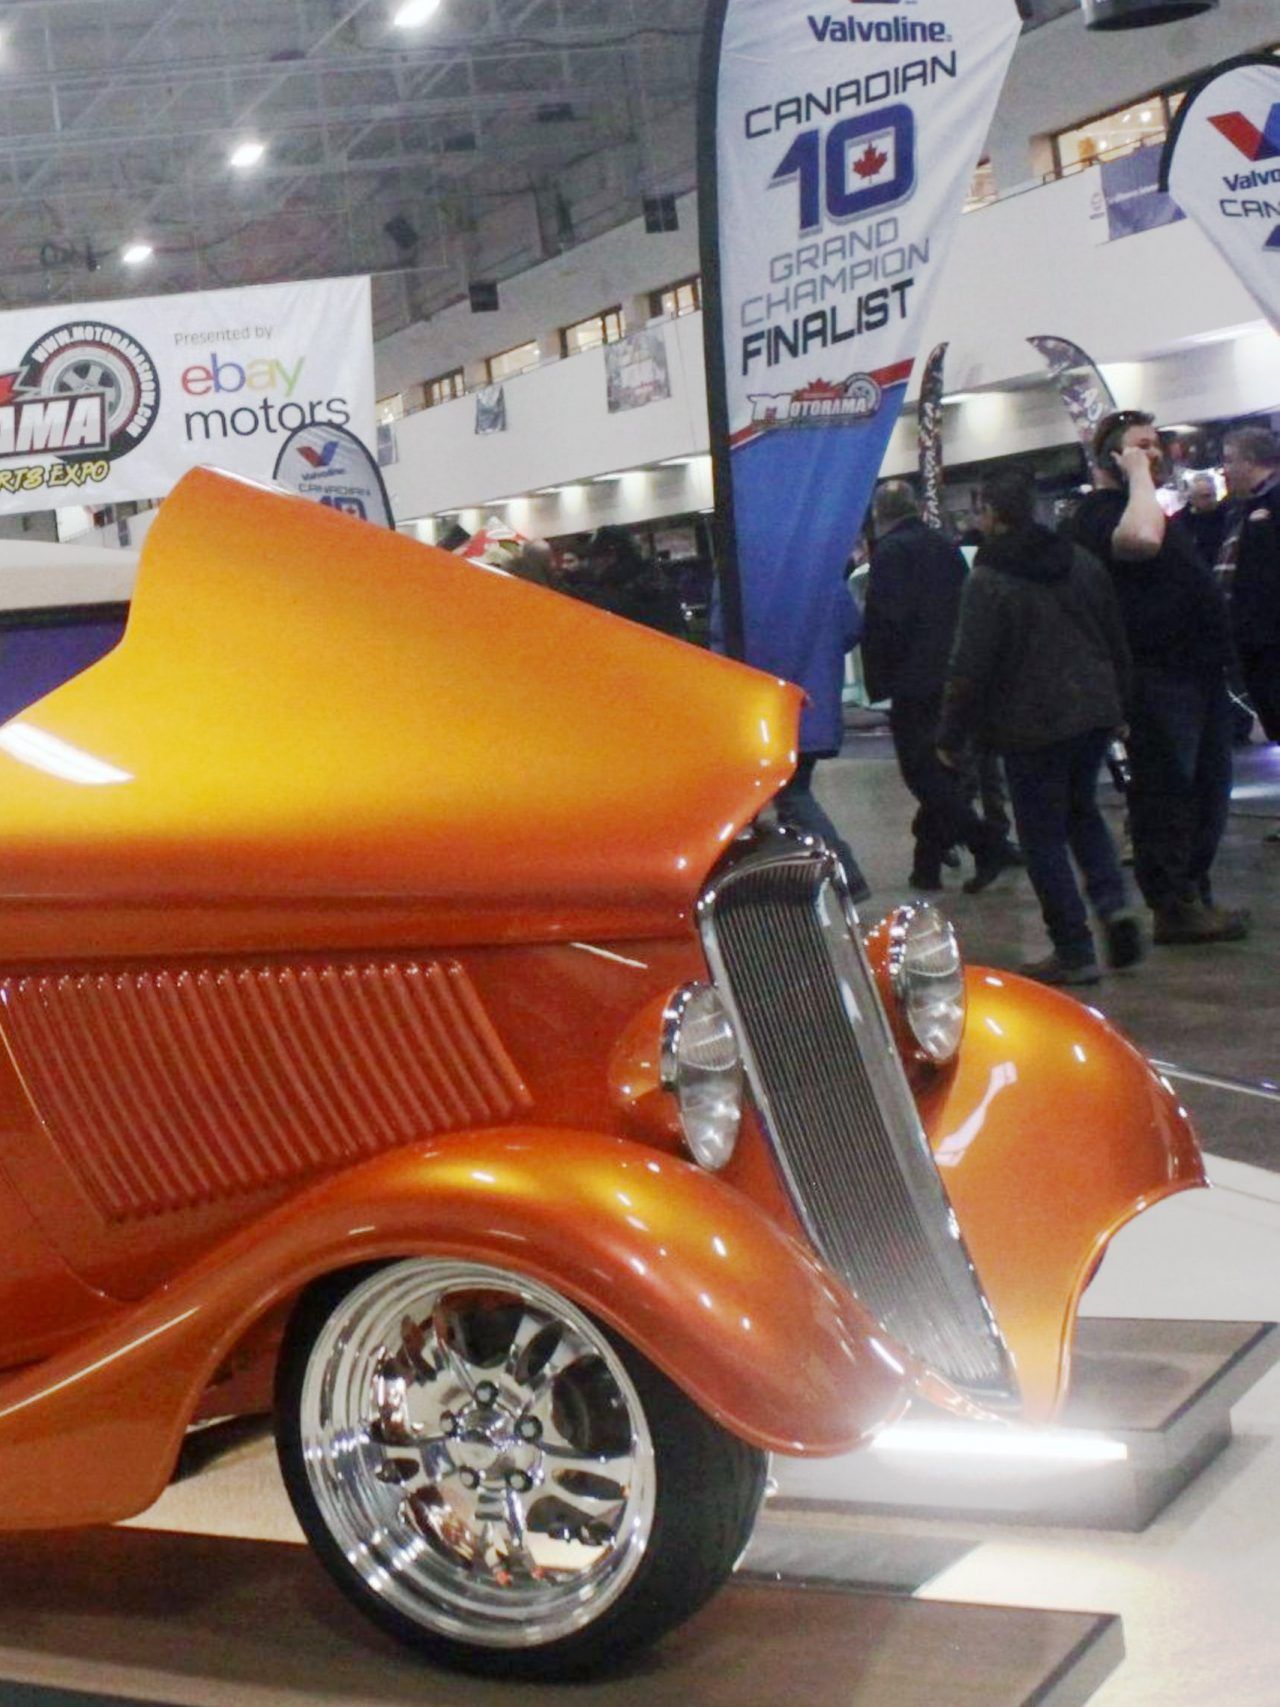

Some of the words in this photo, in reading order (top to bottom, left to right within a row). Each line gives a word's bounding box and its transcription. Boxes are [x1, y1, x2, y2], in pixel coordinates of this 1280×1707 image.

[808, 15, 946, 42] Valvoline
[745, 50, 956, 139] CANADIAN
[770, 102, 917, 234] 10
[769, 217, 899, 284] GRAND
[741, 237, 930, 328] CHAMPION
[174, 326, 250, 345] Presented
[255, 325, 274, 340] by
[742, 278, 914, 376] FINALIST
[181, 352, 305, 397] ebay
[185, 396, 351, 441] motors
[47, 460, 110, 487] EXPO
